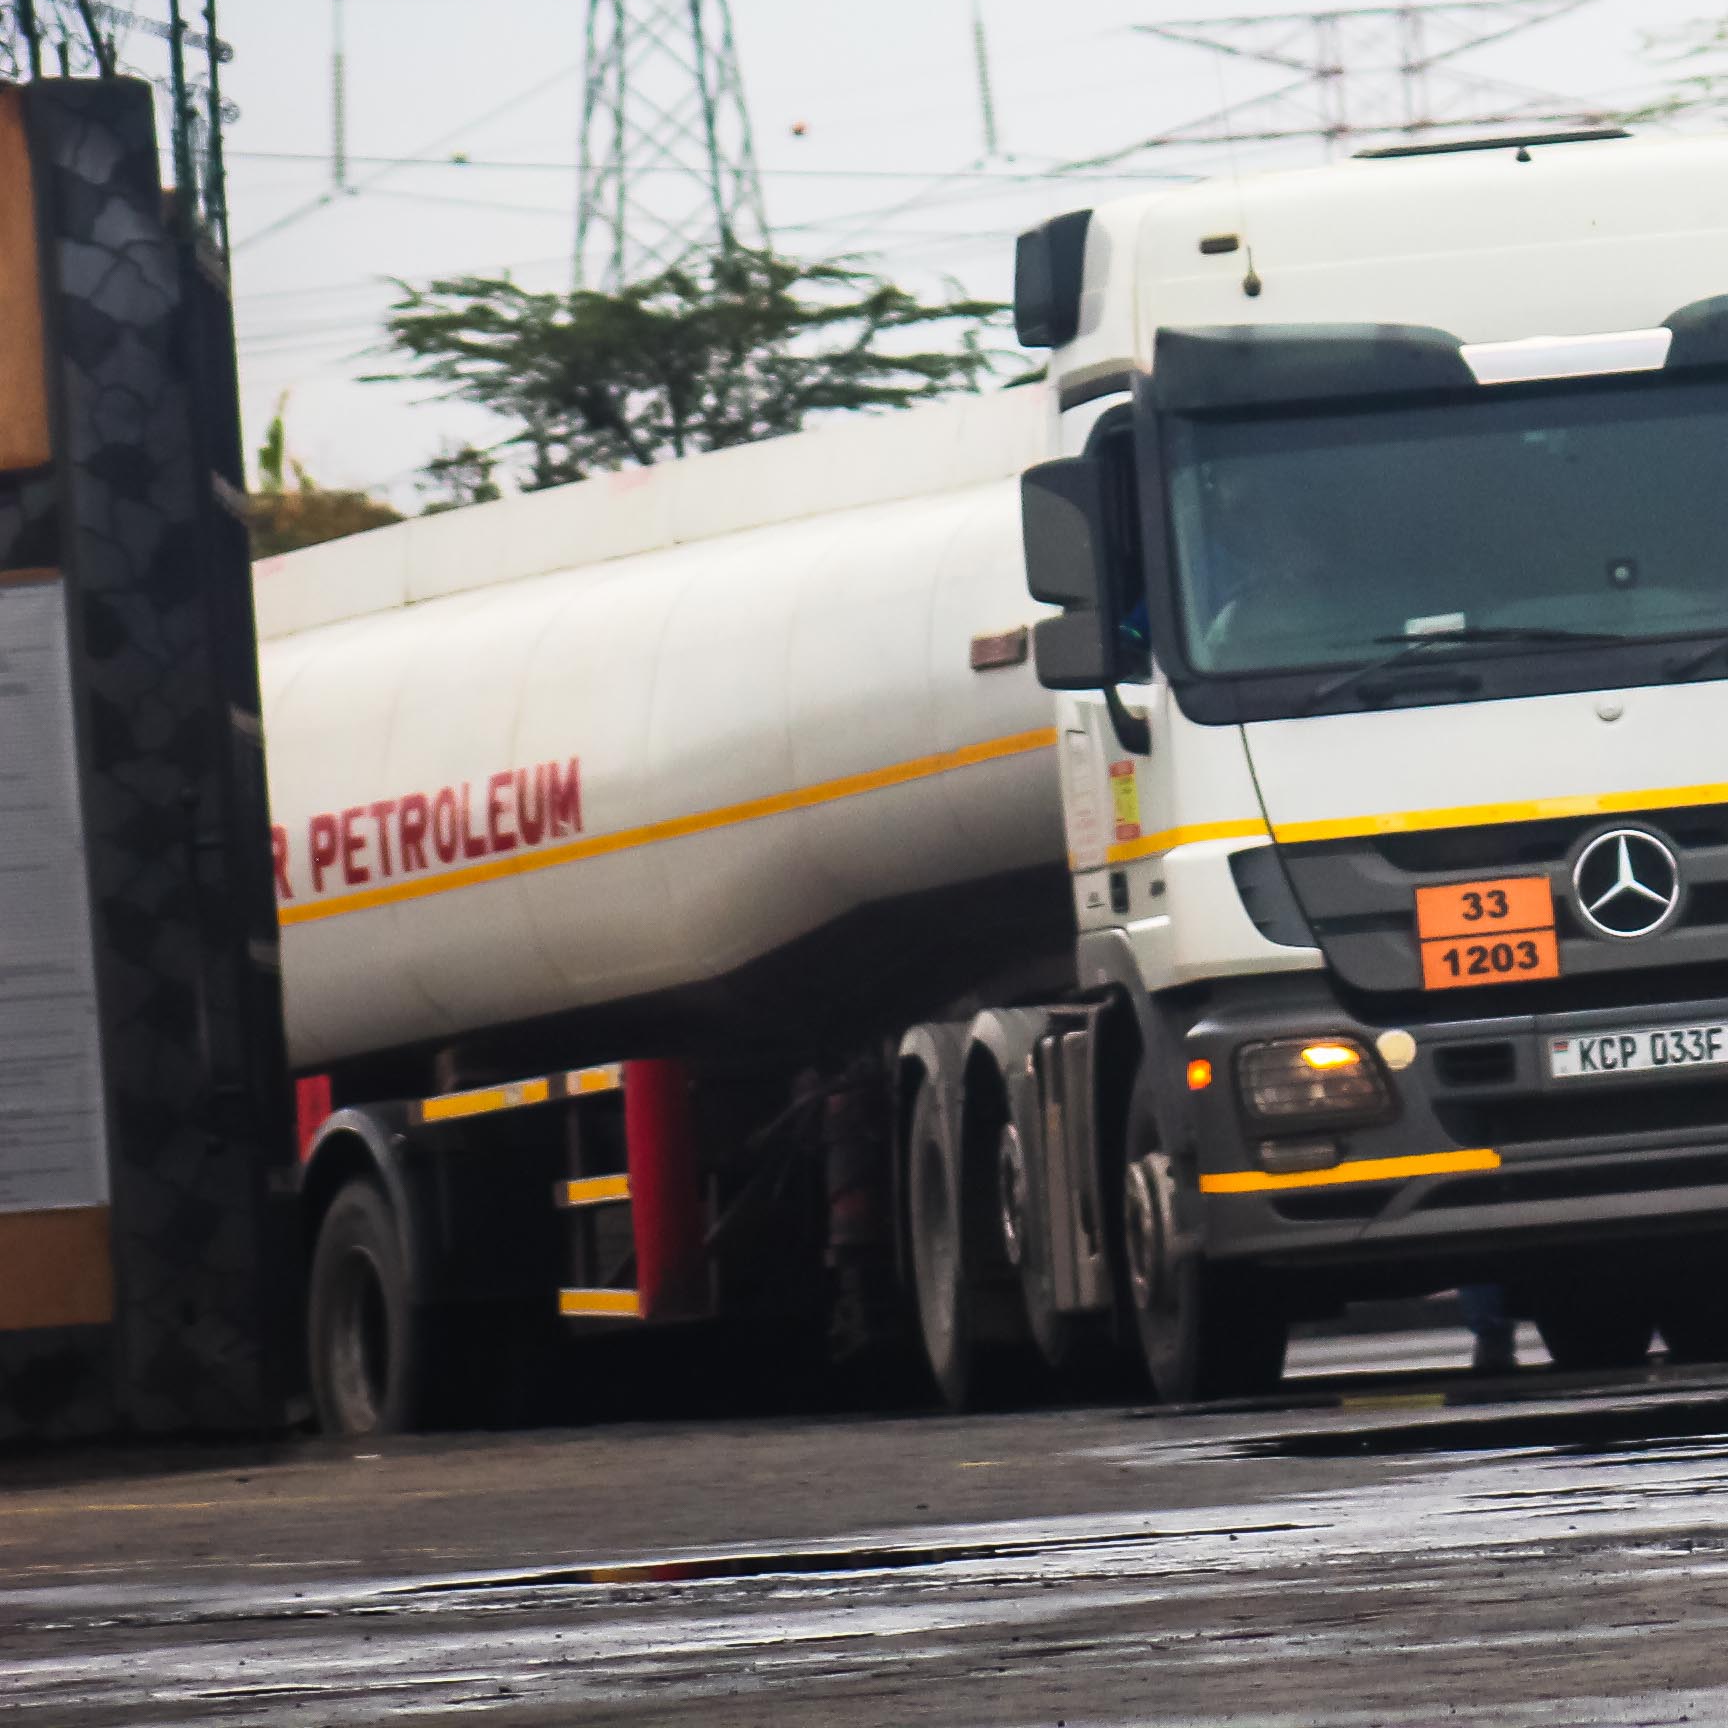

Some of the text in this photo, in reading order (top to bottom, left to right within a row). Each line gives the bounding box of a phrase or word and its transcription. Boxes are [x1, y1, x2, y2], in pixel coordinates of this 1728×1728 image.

[308, 754, 585, 894] PETROLEUM
[1461, 889, 1509, 922] 33
[1442, 940, 1540, 977] 1203
[1577, 1027, 1723, 1071] KCP 033F
